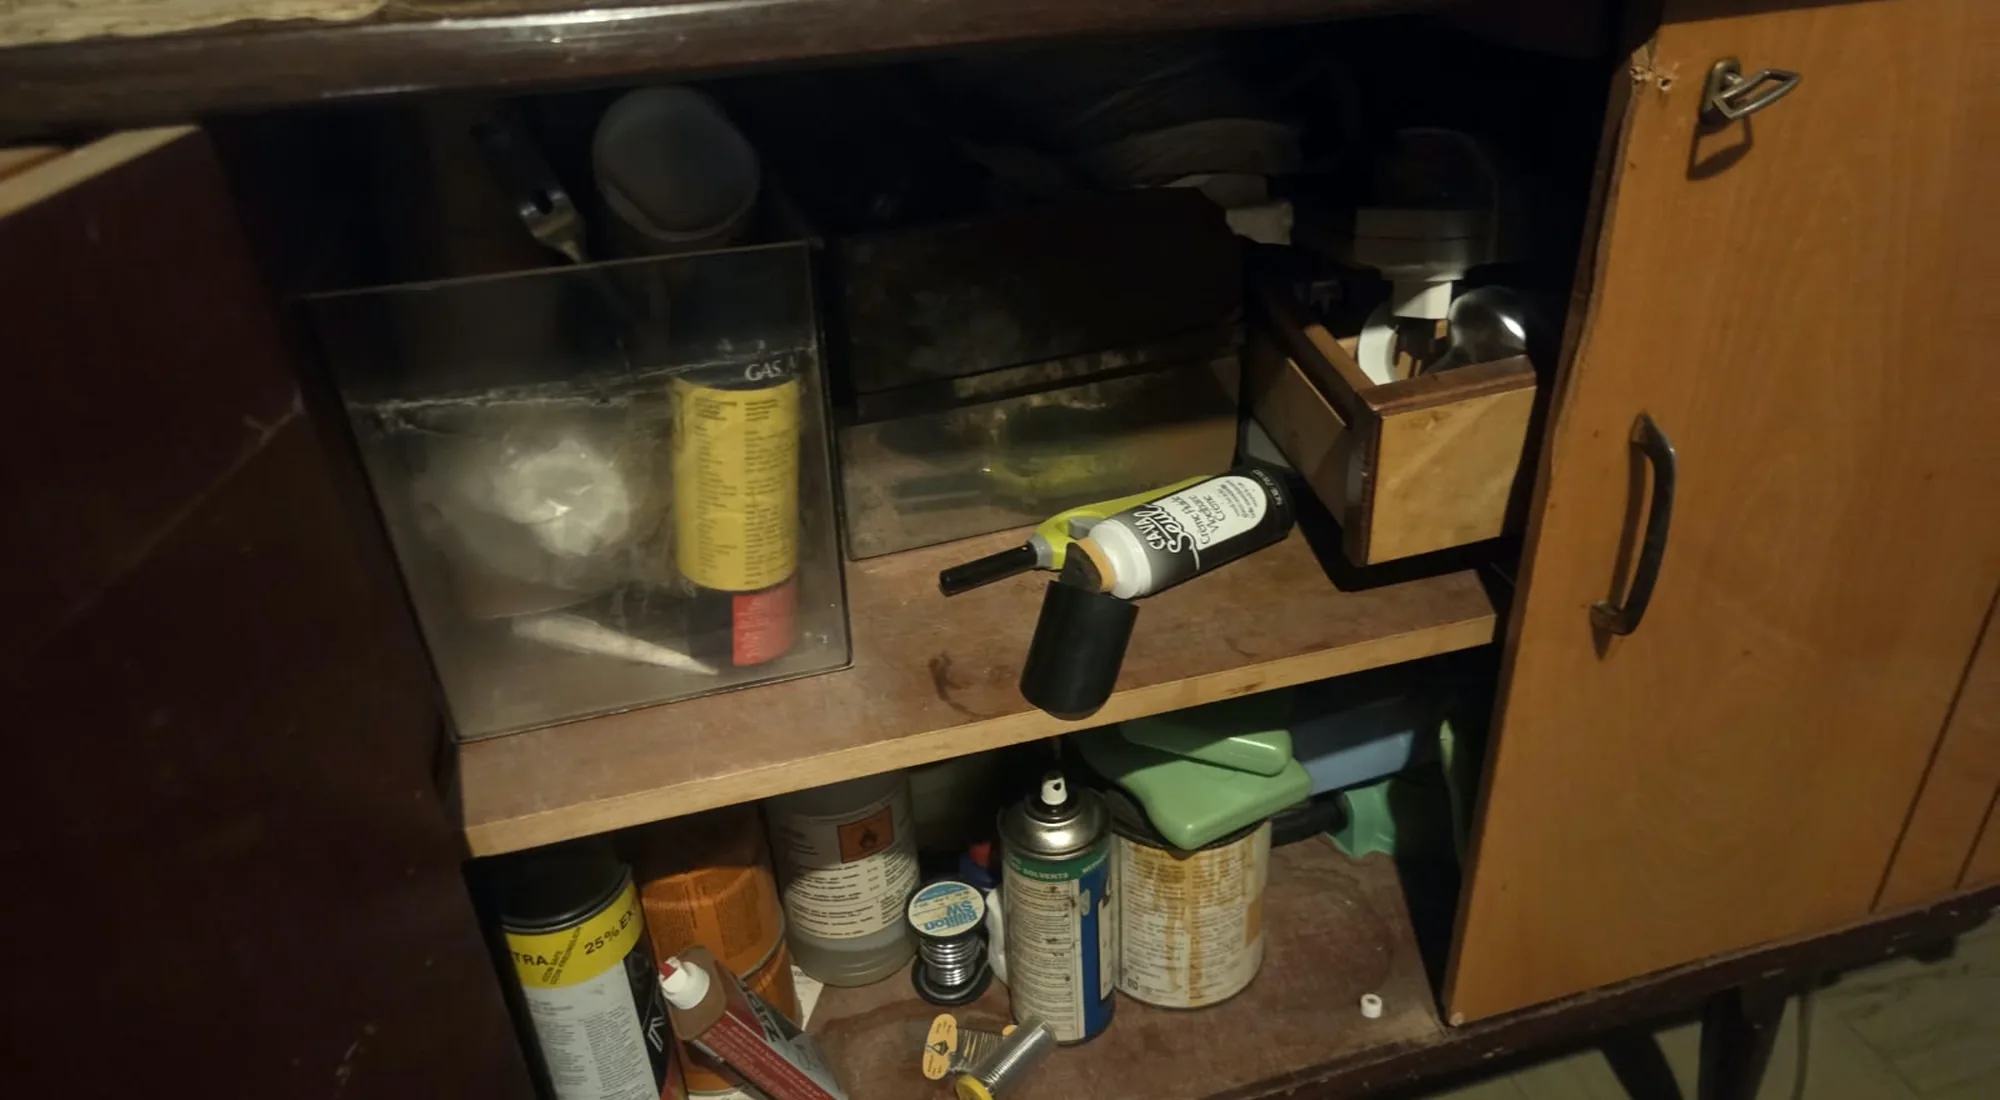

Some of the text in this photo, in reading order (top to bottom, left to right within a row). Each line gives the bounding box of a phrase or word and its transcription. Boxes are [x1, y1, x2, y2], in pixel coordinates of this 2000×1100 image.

[744, 359, 782, 381] GAS
[1023, 867, 1069, 880] SOLVENTS
[583, 925, 620, 956] 25%
